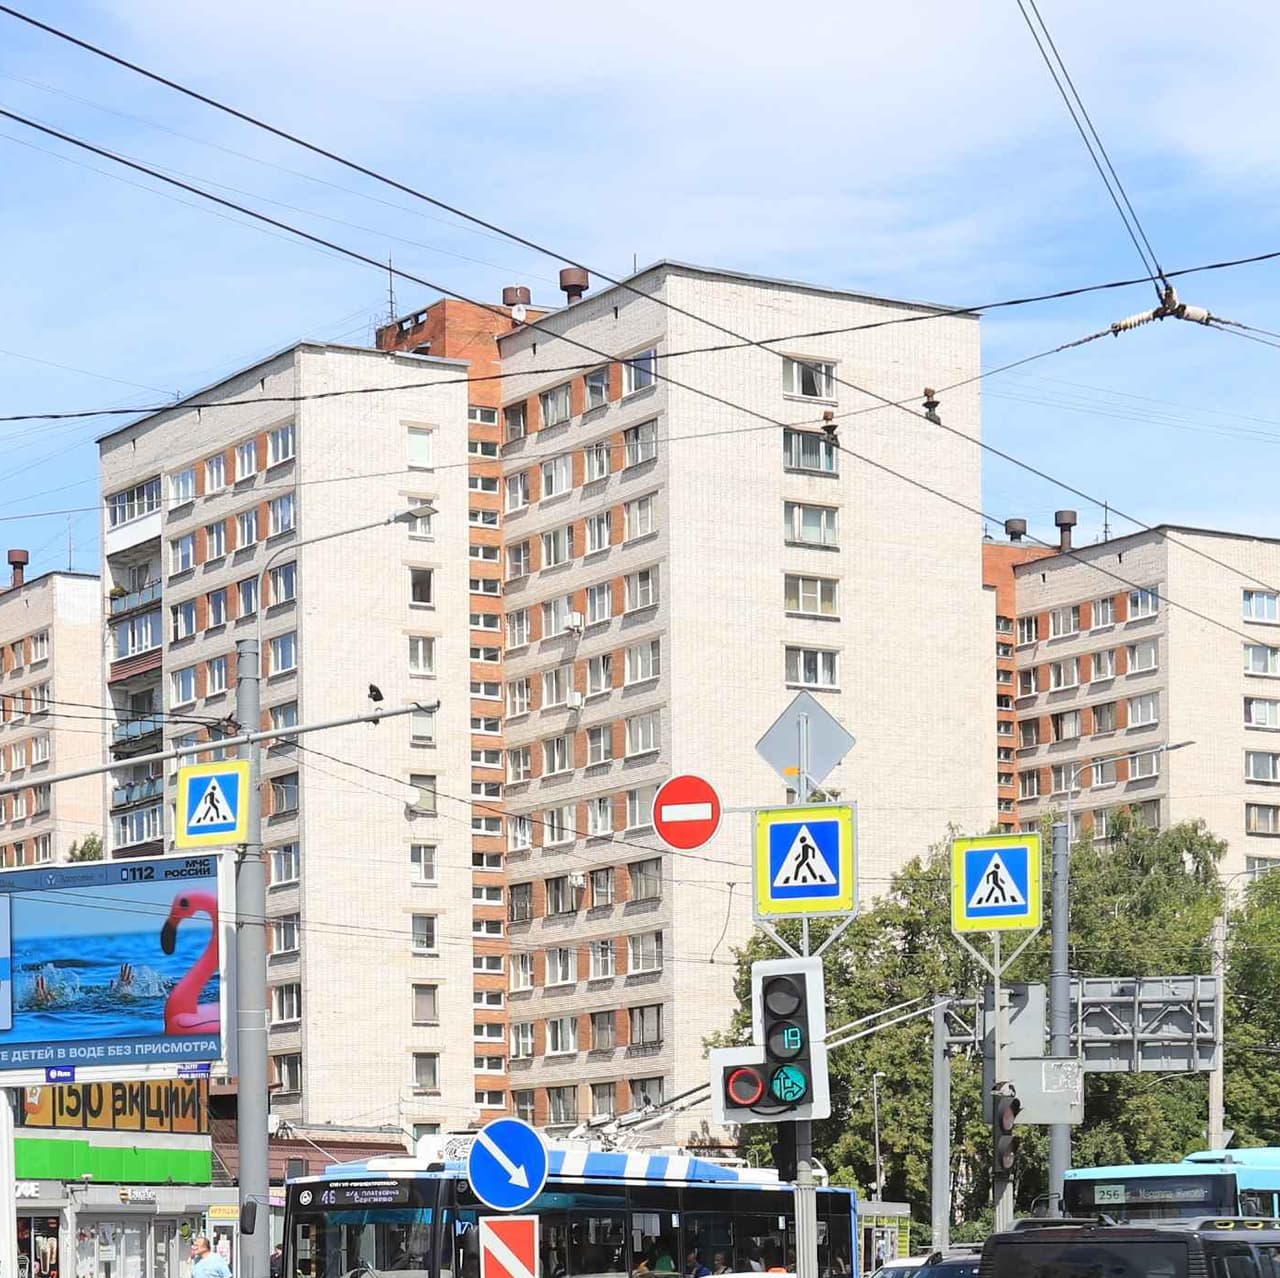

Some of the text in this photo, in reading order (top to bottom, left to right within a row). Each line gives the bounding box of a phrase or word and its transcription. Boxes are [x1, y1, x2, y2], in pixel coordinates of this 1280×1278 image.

[185, 858, 210, 868] МЧС
[130, 867, 155, 881] 112
[164, 867, 211, 879] РОССИИ
[11, 1045, 54, 1062] ДЕТЕЙ
[57, 1048, 66, 1059] В
[69, 1046, 105, 1058] ВОДЕ
[108, 1046, 132, 1057] БЕЗ
[135, 1040, 218, 1055] ПРИСМОТРА
[58, 1080, 199, 1126] 150 акций
[15, 1182, 40, 1197] ОФЕ
[1099, 1189, 1120, 1200] 256
[322, 1190, 336, 1204] 46
